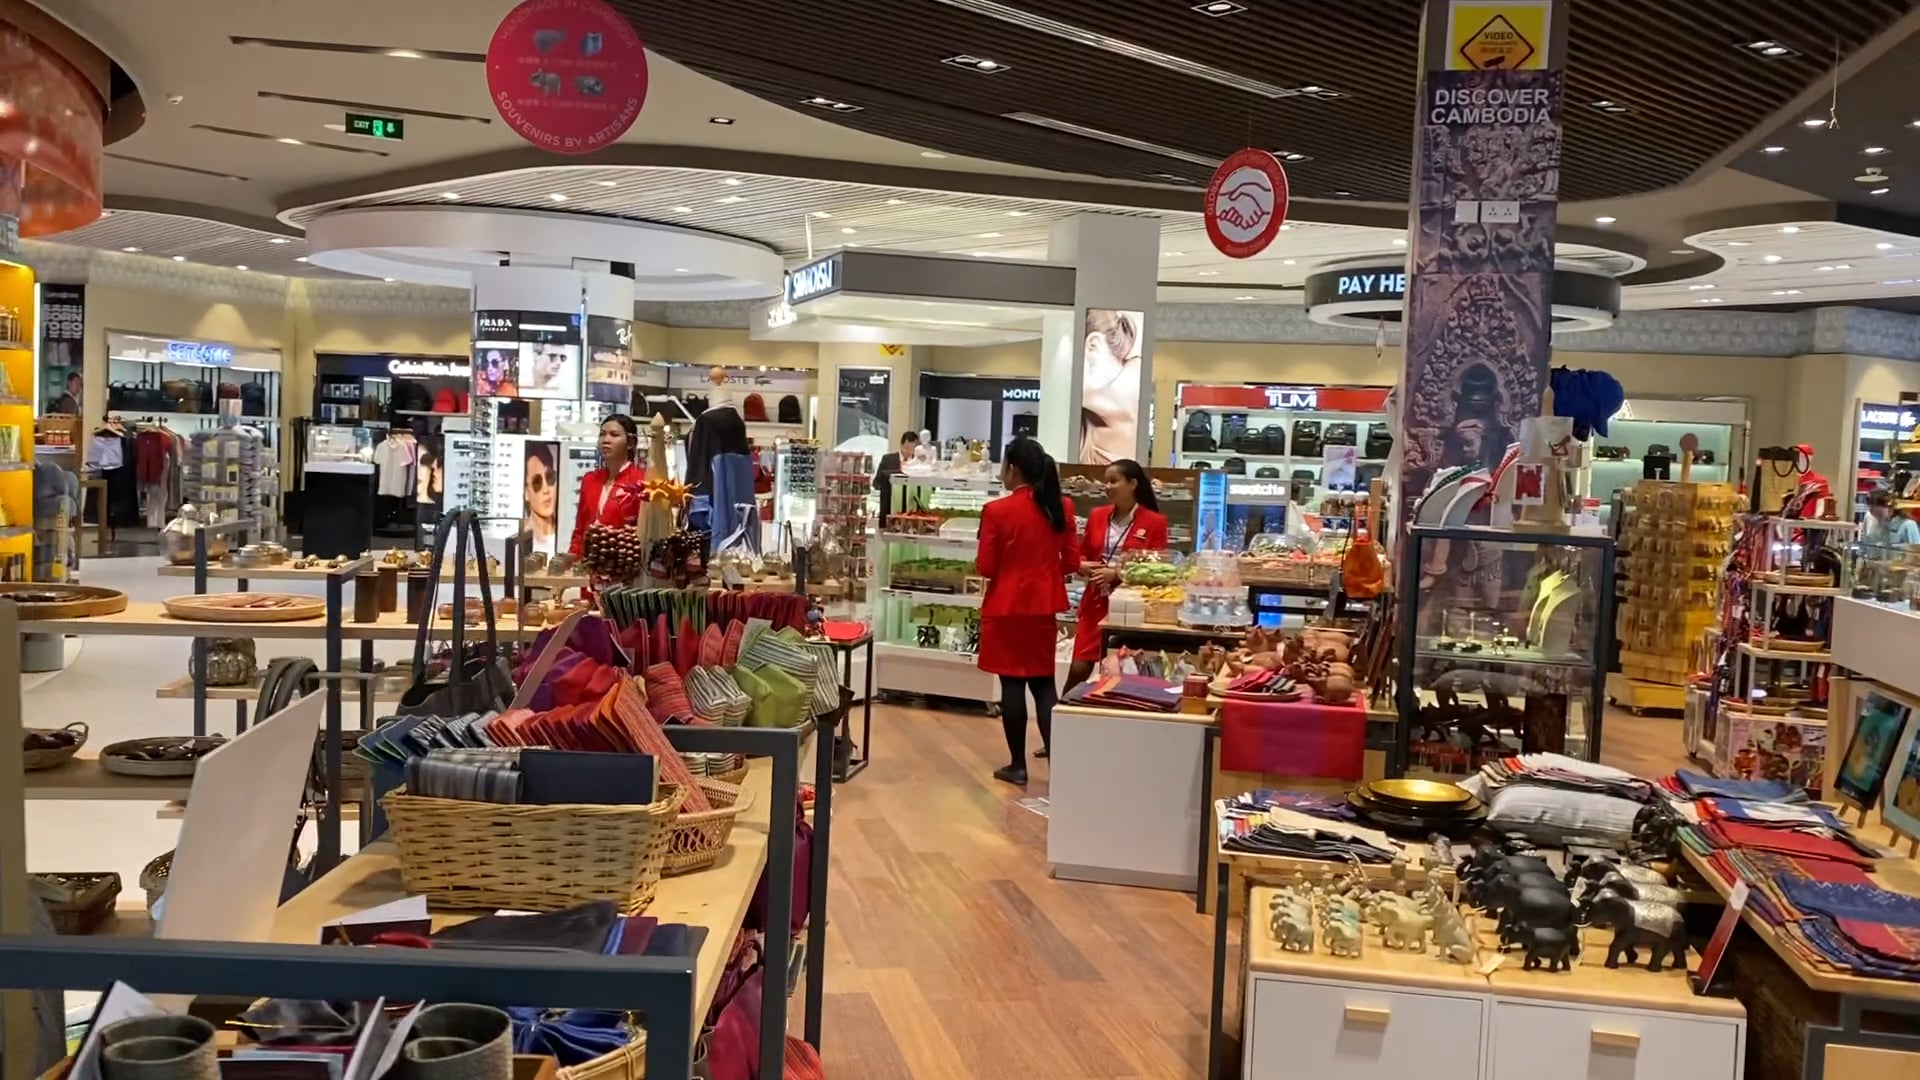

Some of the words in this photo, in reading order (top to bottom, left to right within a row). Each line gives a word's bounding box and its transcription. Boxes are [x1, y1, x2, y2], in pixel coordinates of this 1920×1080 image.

[1483, 31, 1514, 41] VIDEO
[1435, 89, 1550, 105] DISCOVER
[498, 91, 560, 146] SOUVENIRS
[564, 137, 583, 147] BY
[588, 97, 639, 144] ARTISANS
[1431, 107, 1551, 124] CAMBODIA
[353, 120, 370, 129] EXIT
[1338, 275, 1375, 295] PAY
[480, 319, 512, 327] PRADA
[700, 375, 750, 385] LAOSTE
[1264, 390, 1317, 408] TUMI
